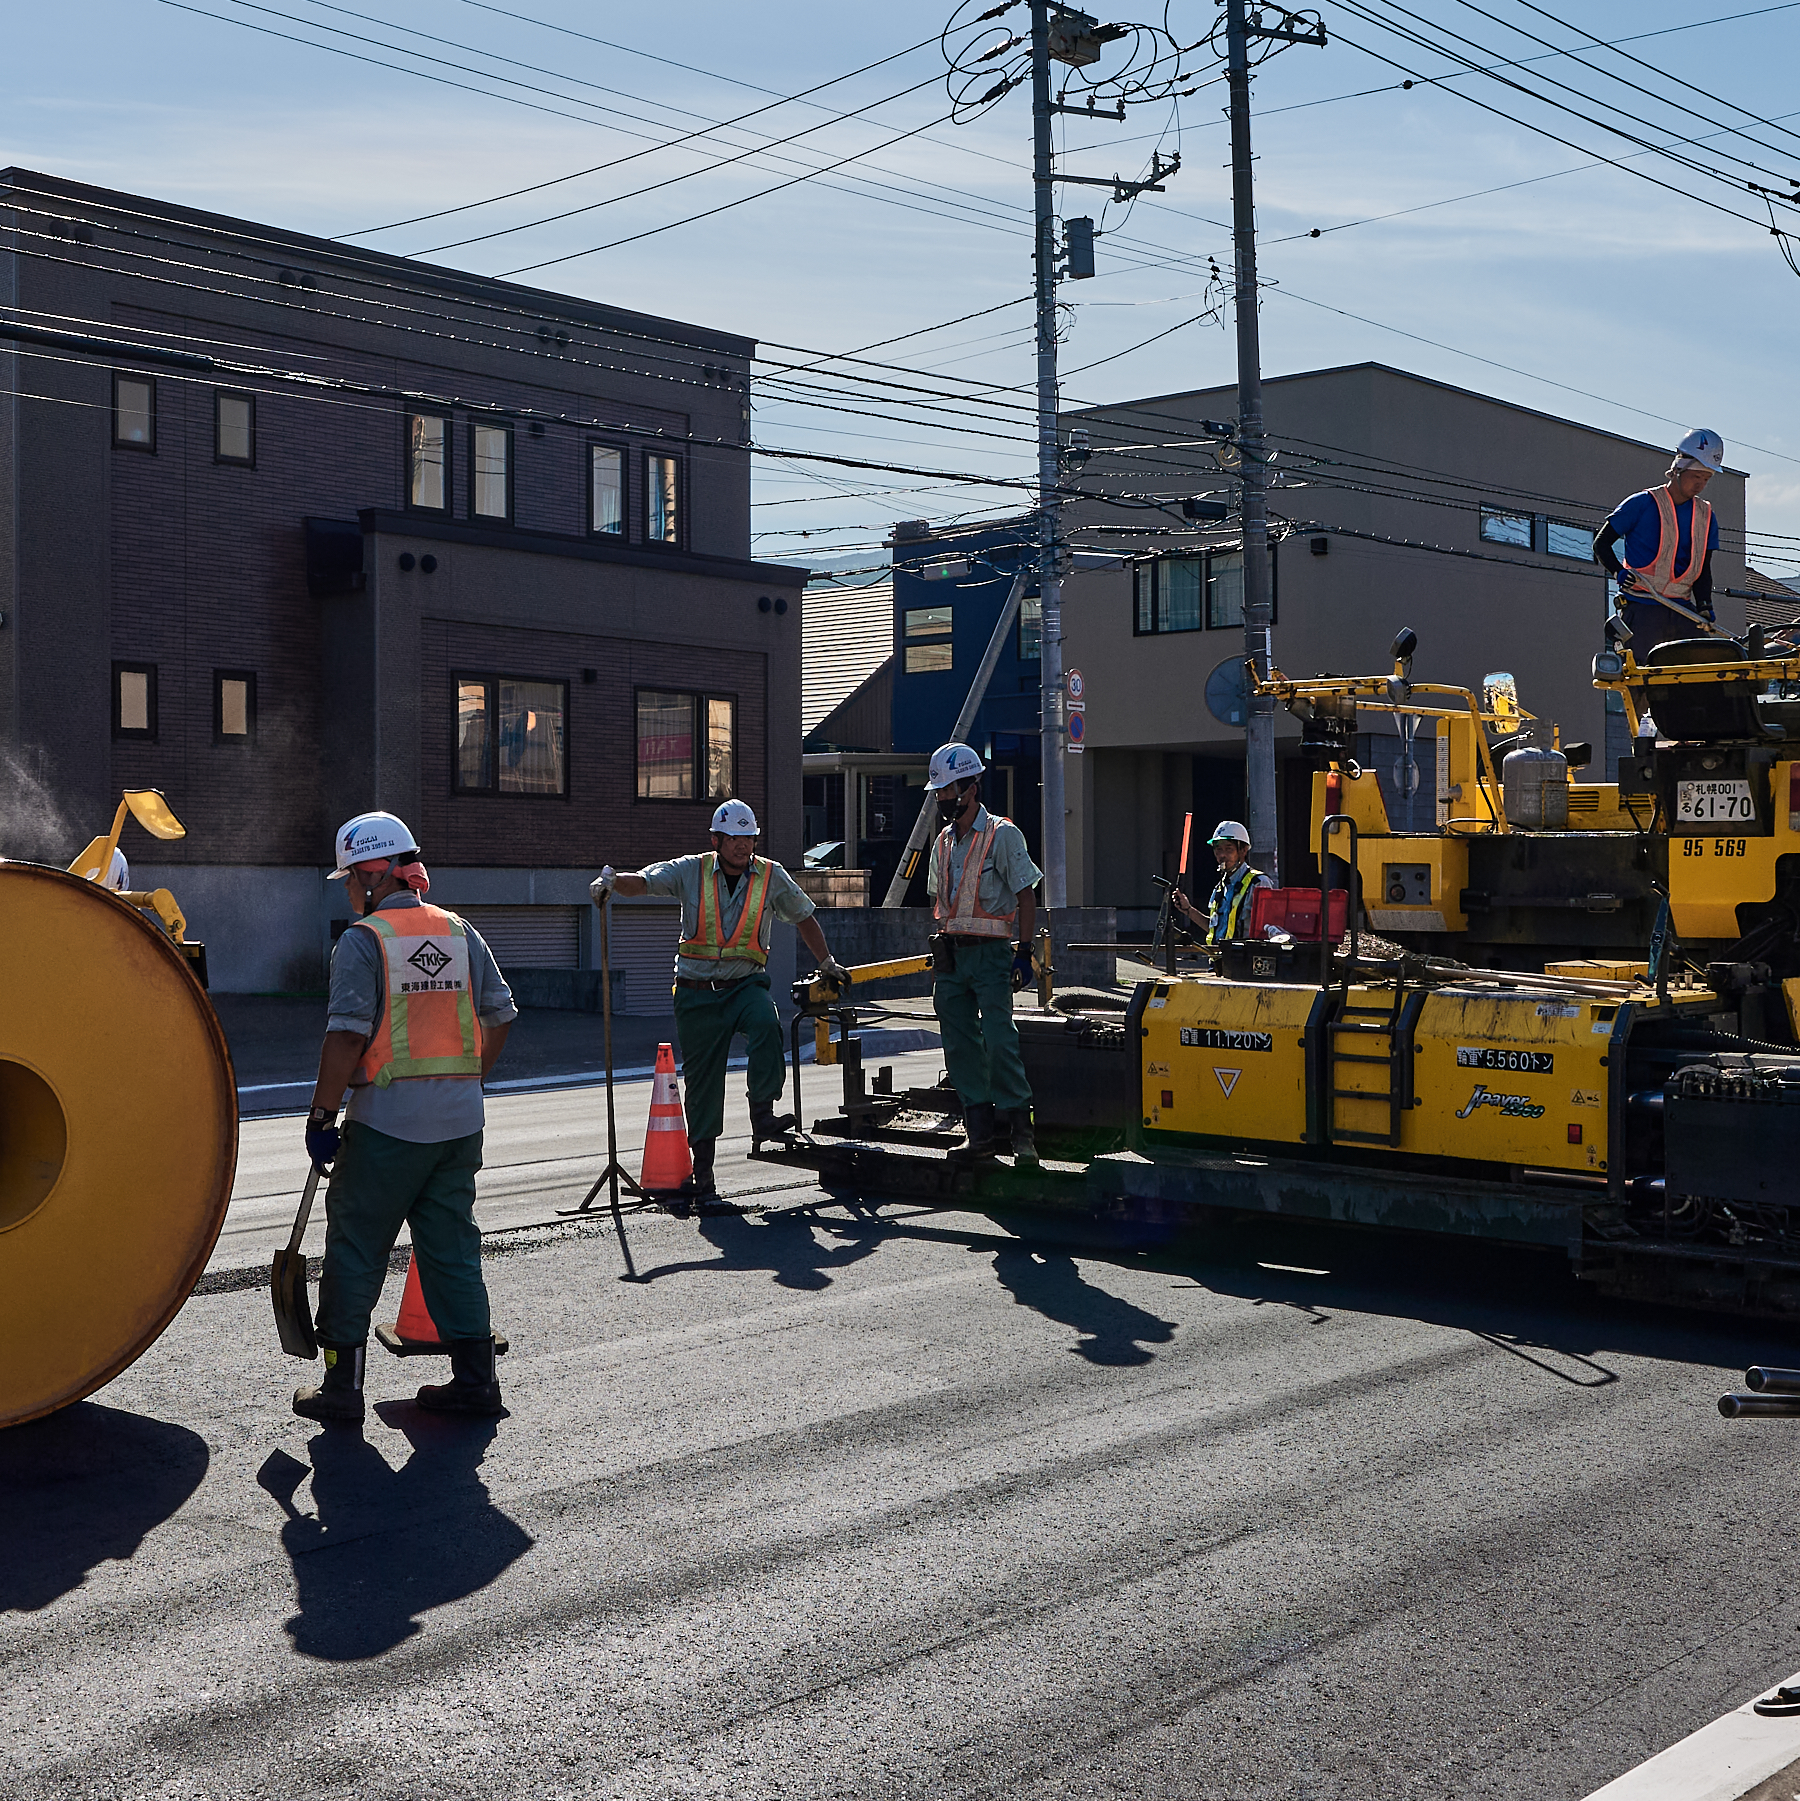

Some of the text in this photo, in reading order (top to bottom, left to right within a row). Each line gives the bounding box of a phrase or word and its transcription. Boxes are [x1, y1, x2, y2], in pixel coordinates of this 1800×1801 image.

[1071, 678, 1081, 692] 30
[1695, 783, 1736, 795] 札幌001
[1694, 796, 1751, 818] 61-70
[1683, 839, 1747, 857] 95 569
[419, 953, 440, 967] TKK
[1486, 1049, 1553, 1071] 5.560トン
